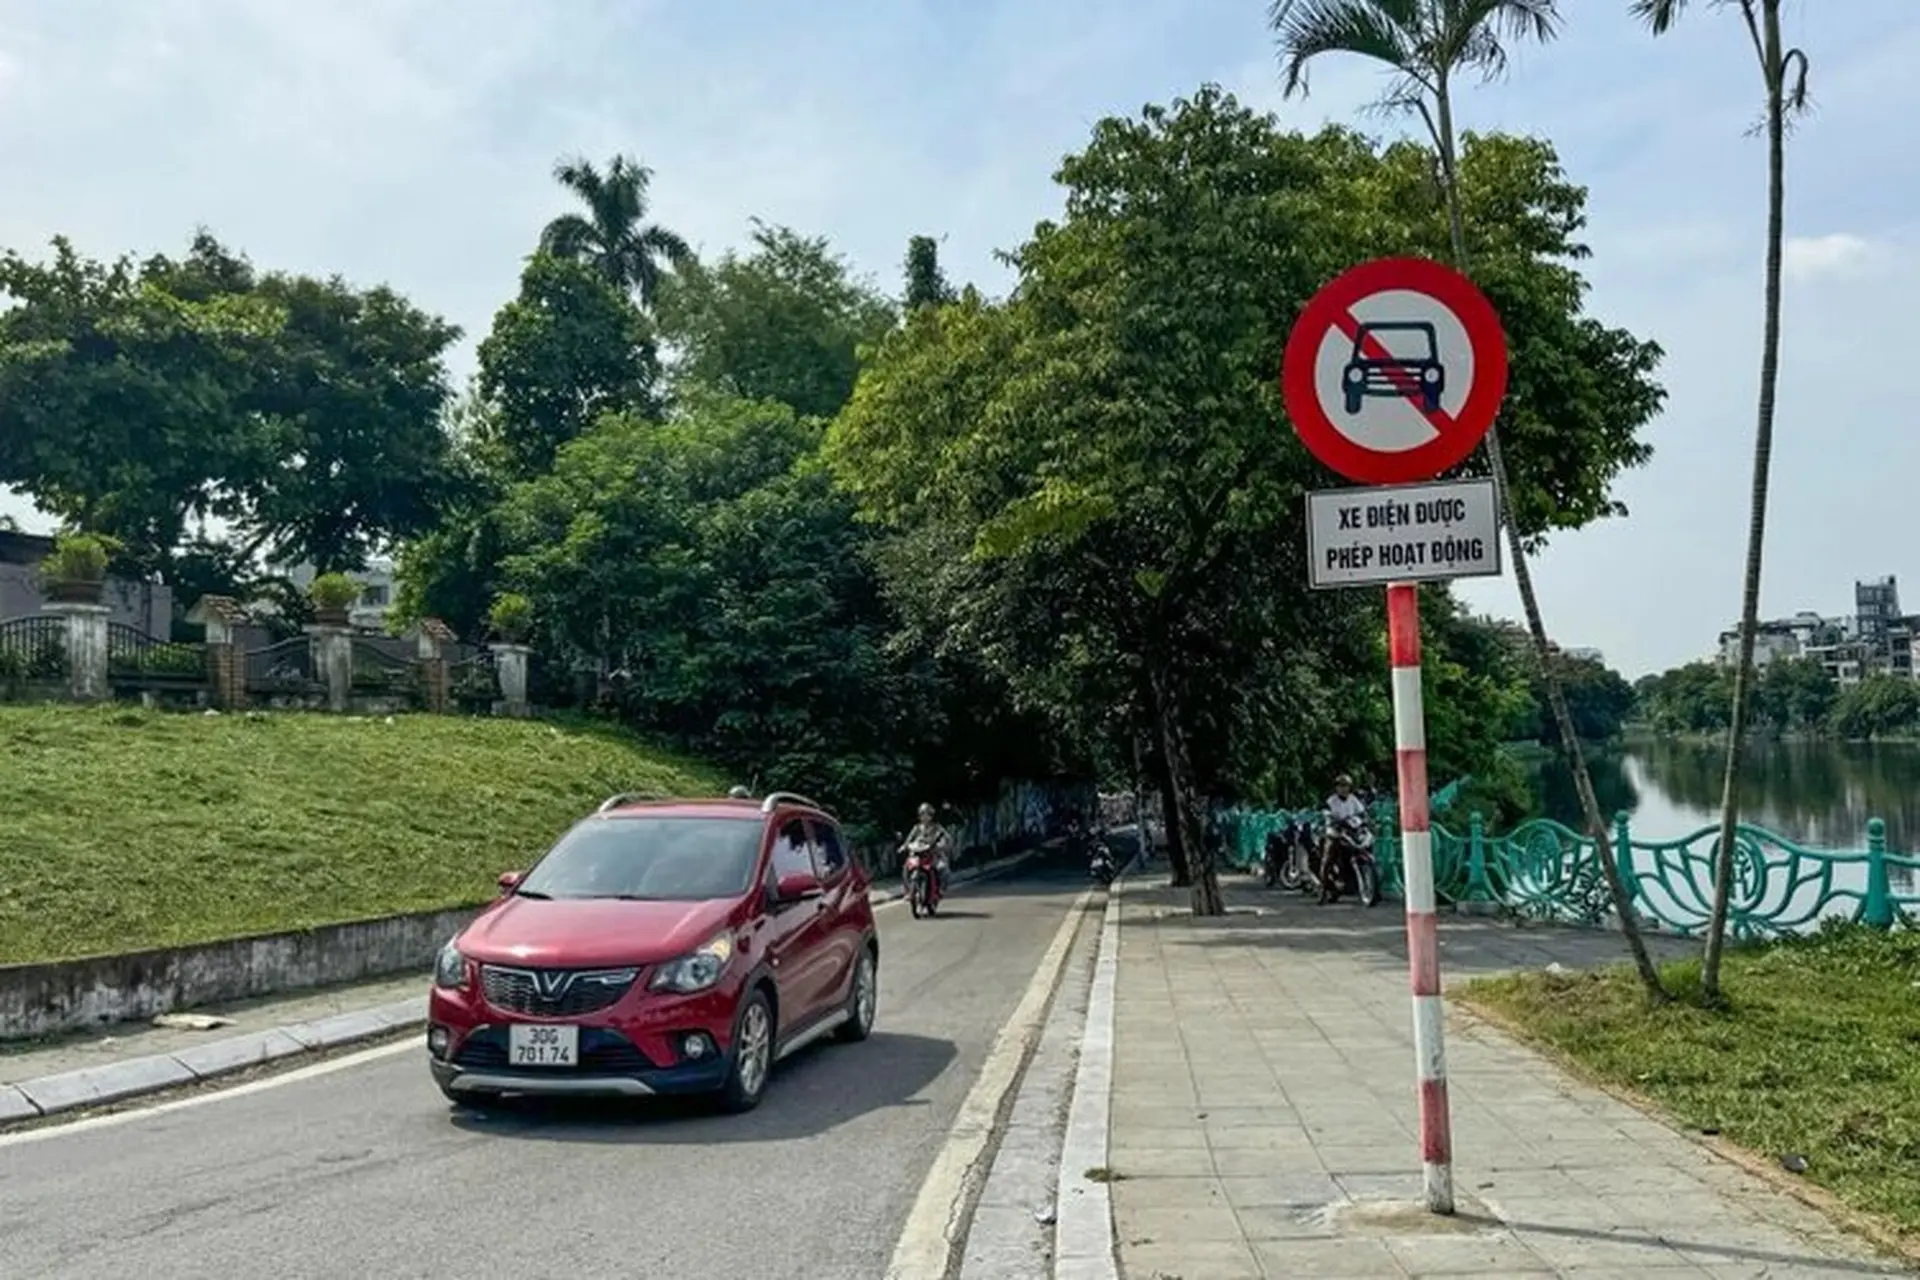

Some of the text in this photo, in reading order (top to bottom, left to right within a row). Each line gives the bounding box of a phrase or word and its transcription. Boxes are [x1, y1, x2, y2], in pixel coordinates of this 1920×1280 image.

[1338, 506, 1361, 530] XE
[1366, 499, 1410, 532] ĐIỆN
[1326, 535, 1484, 572] PHÉP HOẠT ĐỘNG
